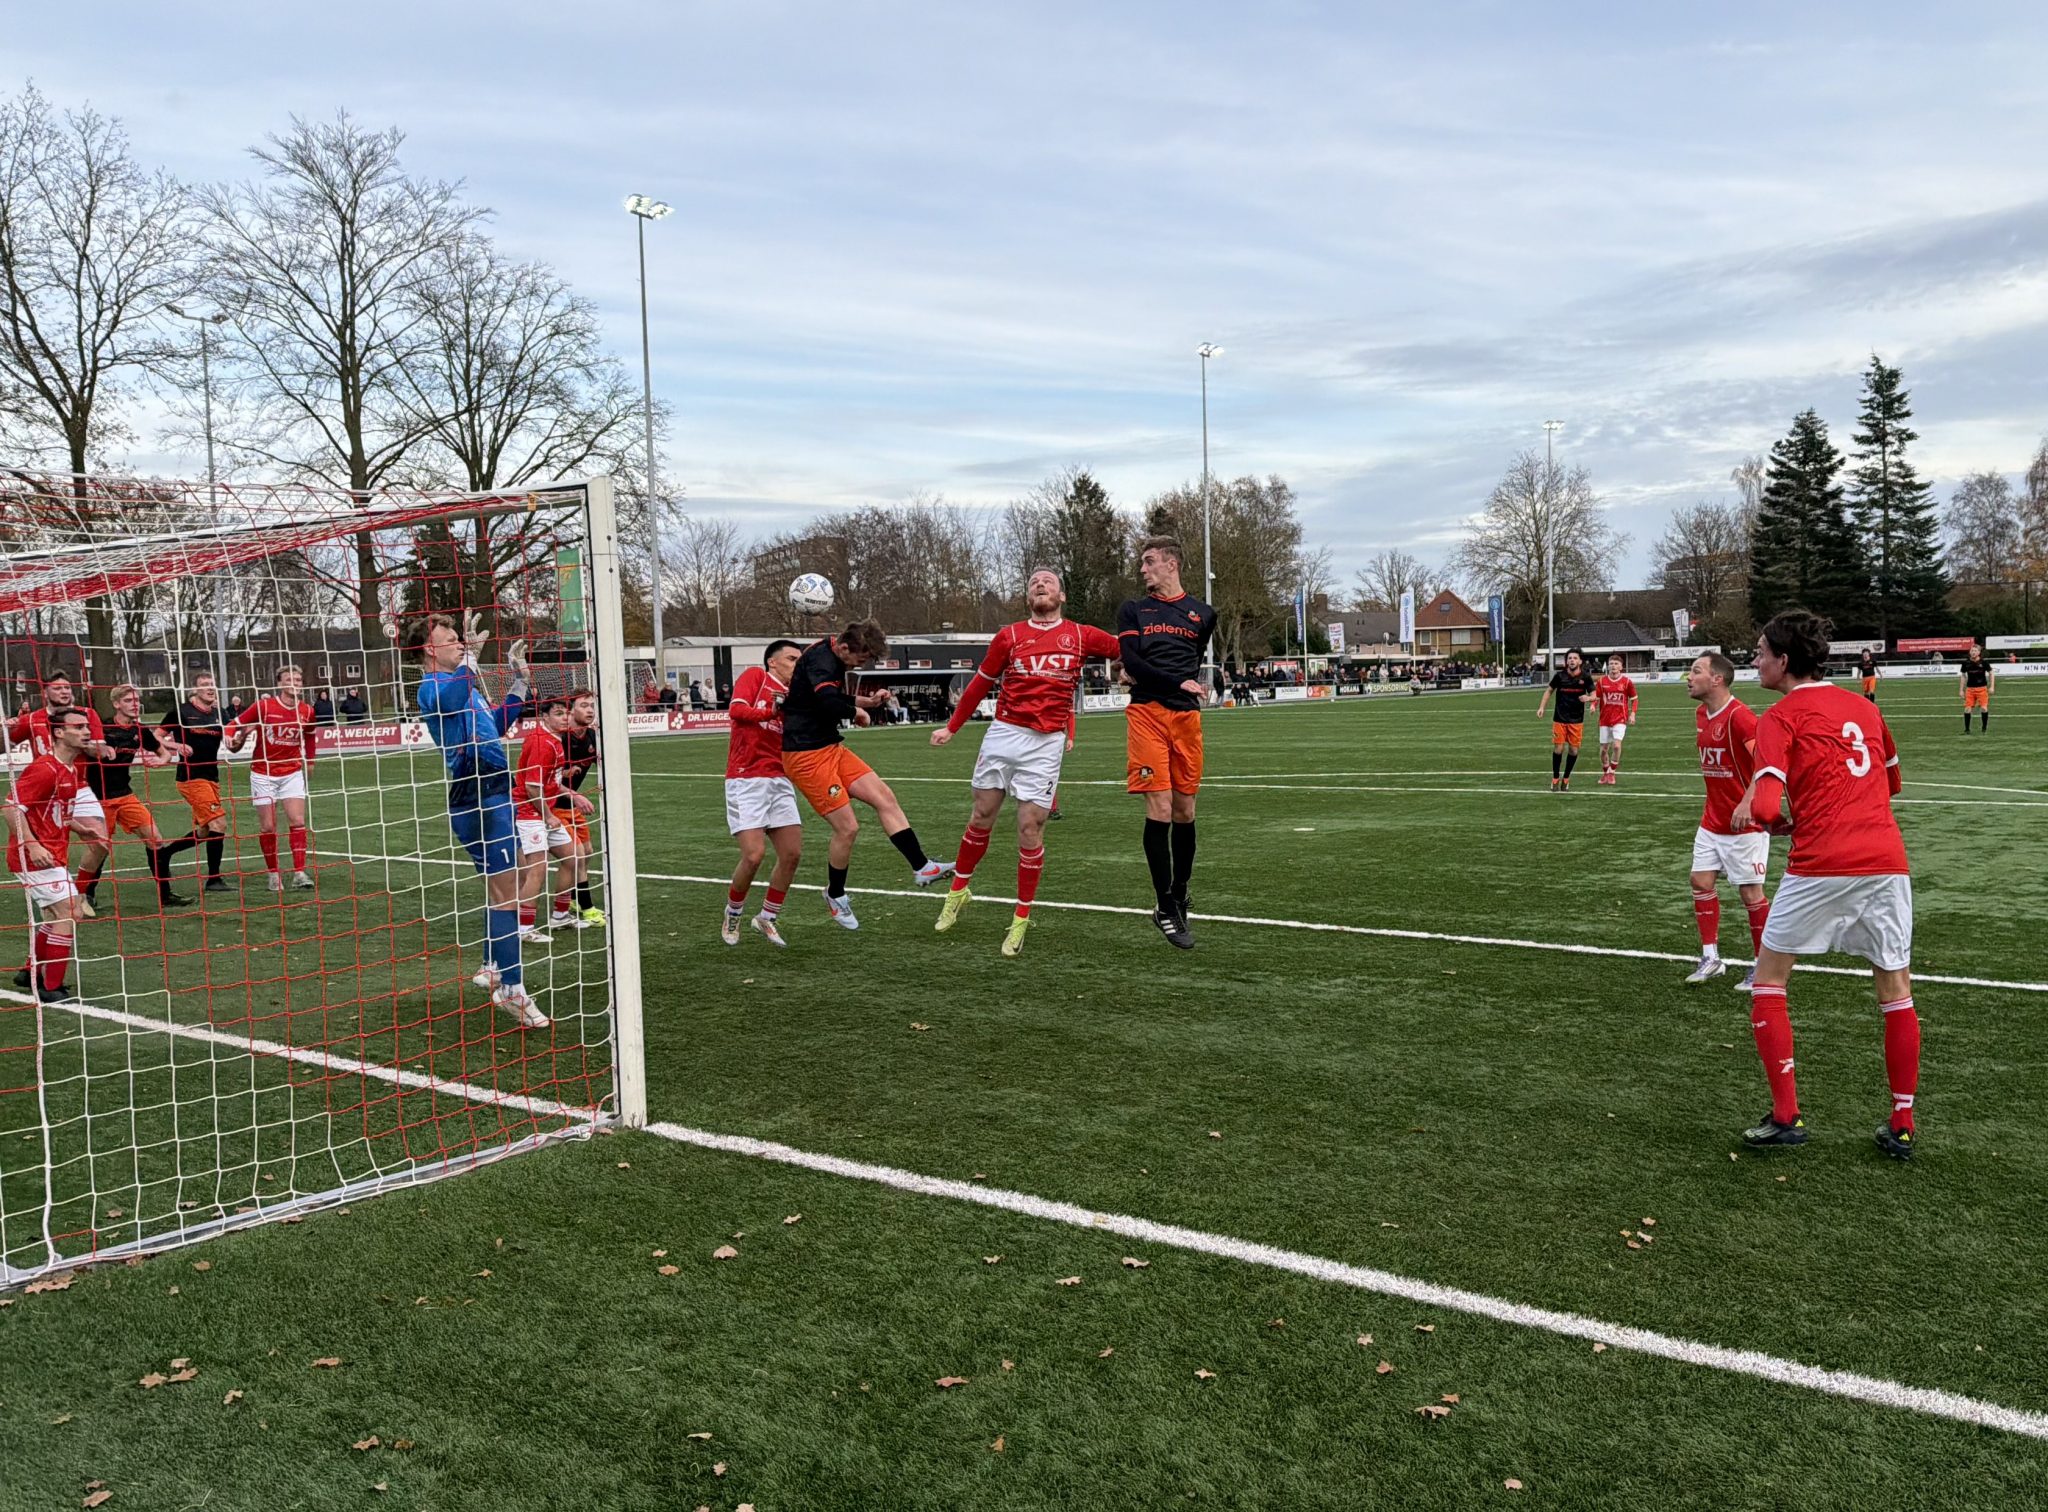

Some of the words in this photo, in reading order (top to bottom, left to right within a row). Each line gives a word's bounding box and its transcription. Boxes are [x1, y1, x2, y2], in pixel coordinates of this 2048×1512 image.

[1030, 654, 1075, 671] VST
[1607, 692, 1624, 701] VST
[323, 726, 398, 740] DR.WEIGERT
[1842, 721, 1871, 777] 3
[1699, 747, 1726, 767] VST
[1046, 781, 1054, 795] 2
[501, 848, 510, 864] 1
[1752, 862, 1766, 876] 10
